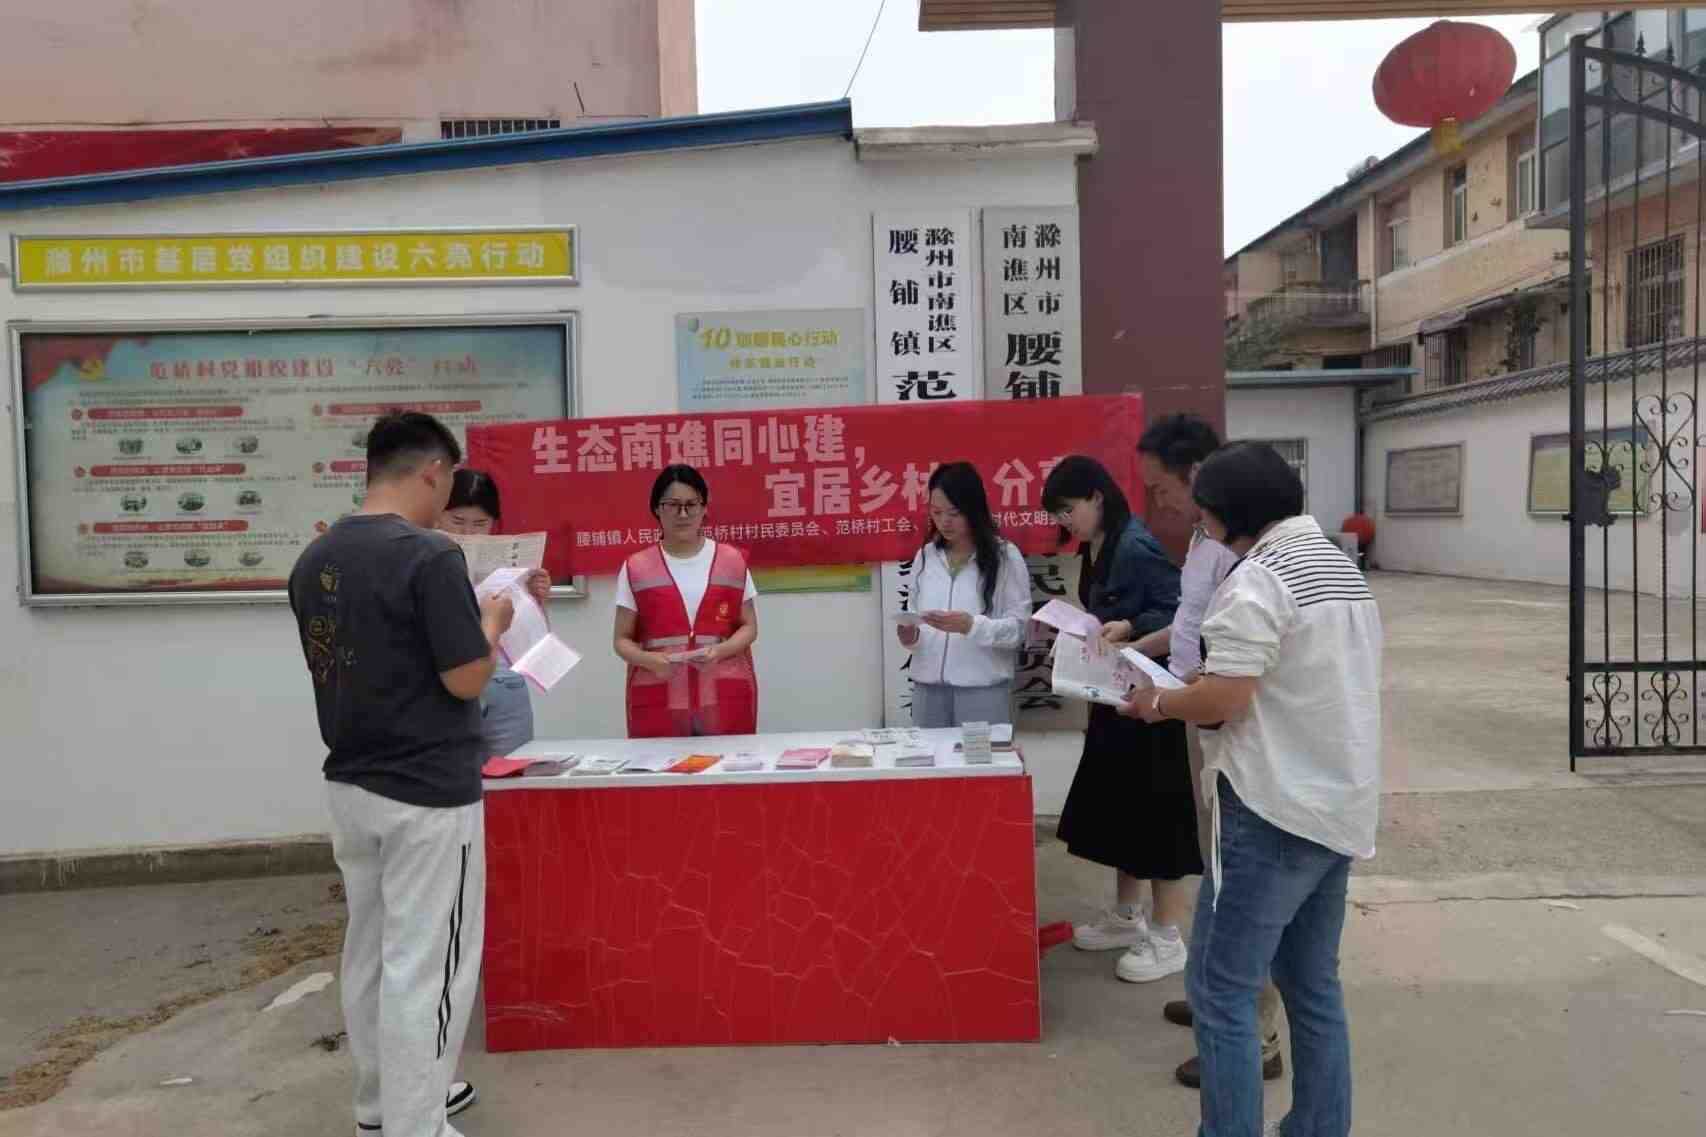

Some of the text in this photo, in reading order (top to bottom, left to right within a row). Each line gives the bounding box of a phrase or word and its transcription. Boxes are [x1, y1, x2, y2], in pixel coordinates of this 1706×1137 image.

[889, 228, 921, 356] 腰铺镇
[926, 227, 956, 353] 滁州市南谯区
[1002, 224, 1028, 315] 南谯区
[1034, 223, 1062, 315] 滁州市
[531, 414, 865, 473] 生态南谯同心建，
[765, 456, 1065, 517] 宜居乡村分
